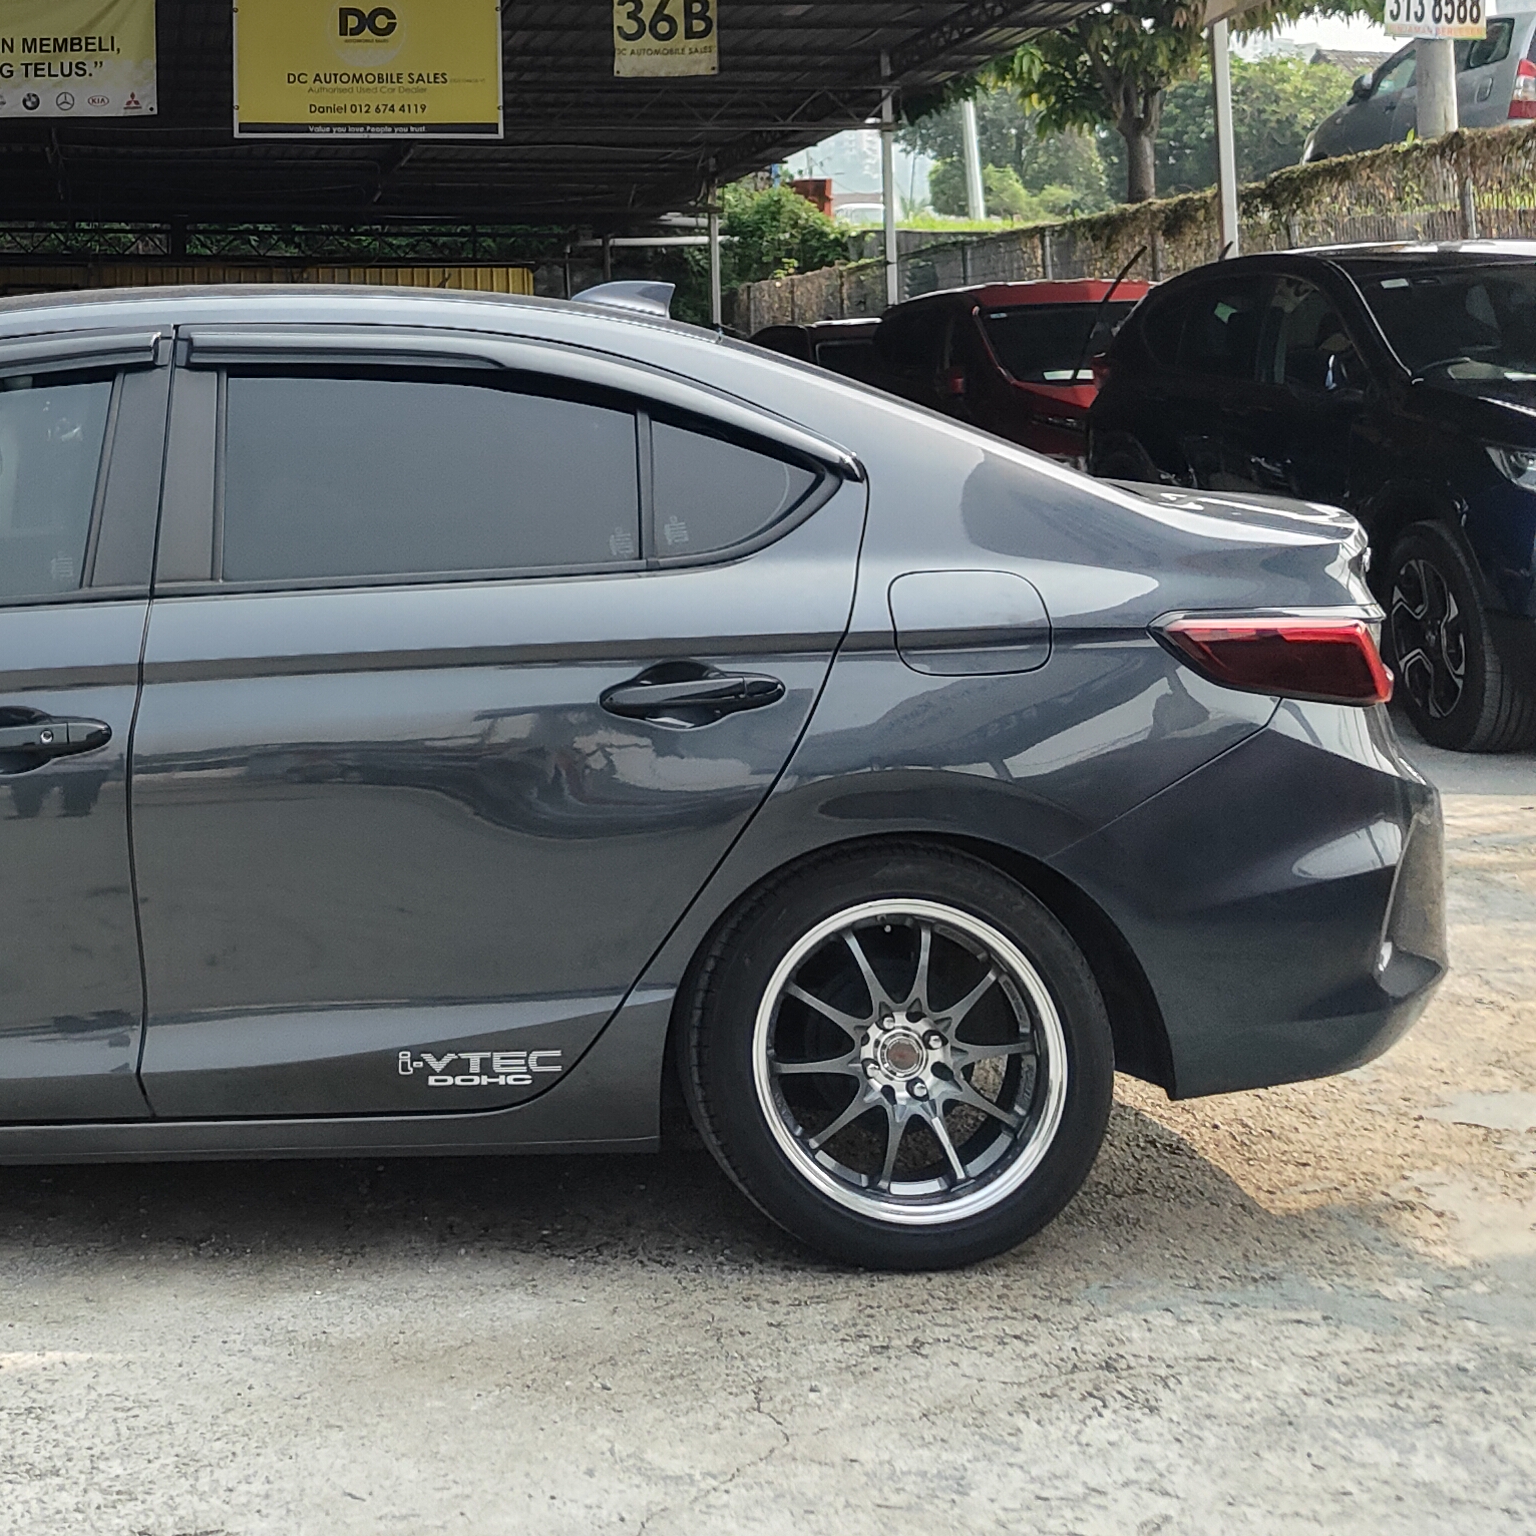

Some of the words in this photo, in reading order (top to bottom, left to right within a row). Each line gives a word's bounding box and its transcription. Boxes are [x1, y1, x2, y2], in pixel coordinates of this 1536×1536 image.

[338, 7, 397, 37] DC
[21, 36, 122, 55] MEMBELI,
[630, 48, 686, 56] AUTOMOBILE
[688, 46, 713, 55] SALES
[287, 73, 308, 84] DC
[312, 72, 404, 84] AUTOMOBILE
[407, 72, 448, 84] SALES
[307, 86, 352, 95] Authorised
[356, 86, 378, 95] Used
[381, 86, 396, 95] Car
[398, 86, 427, 95] Dealer
[309, 103, 347, 114] Daniel
[350, 104, 372, 114] 012
[374, 104, 396, 114] 674
[399, 104, 427, 114] 4119
[308, 125, 330, 133] Value
[366, 125, 392, 134] People
[398, 1050, 562, 1075] i-VTEC
[427, 1074, 533, 1086] DOHC
